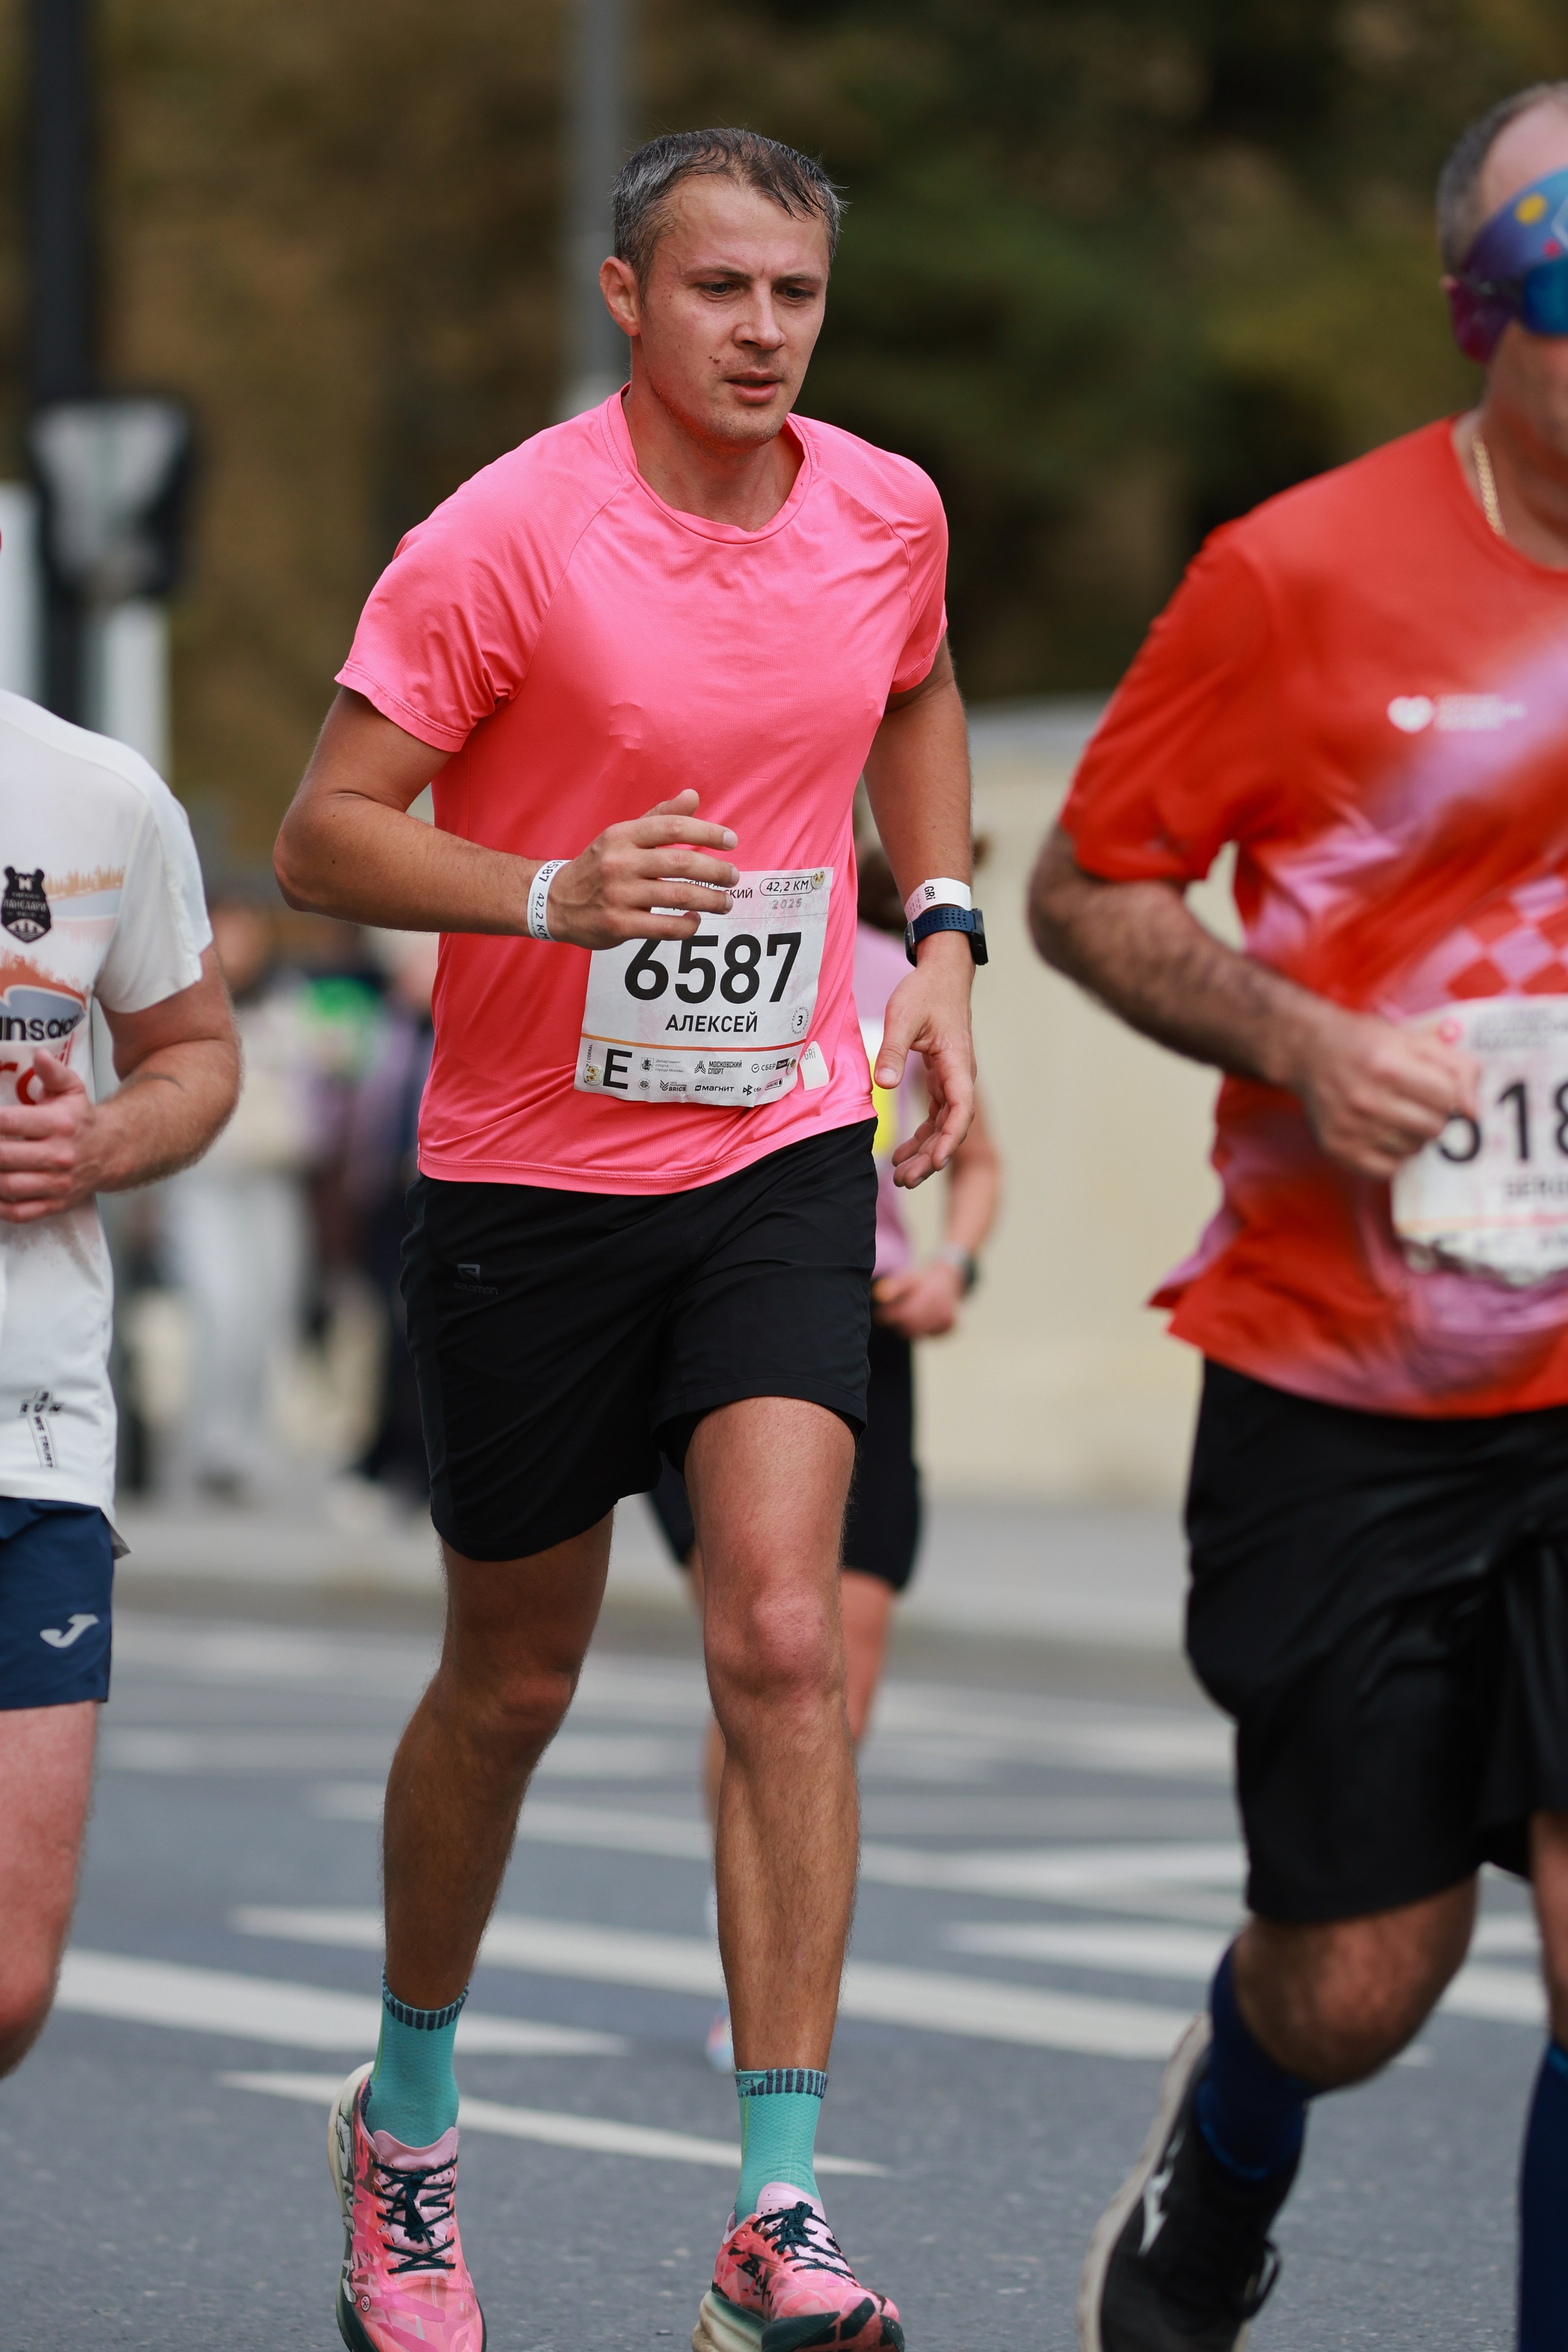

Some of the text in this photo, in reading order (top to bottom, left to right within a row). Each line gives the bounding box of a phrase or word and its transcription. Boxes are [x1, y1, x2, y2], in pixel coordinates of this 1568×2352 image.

[766, 881, 790, 894] 42,2
[924, 886, 936, 900] GRi
[535, 892, 545, 919] 42,2
[771, 897, 802, 910] 2026
[624, 932, 802, 1004] 6587
[665, 1012, 758, 1033] АЛЕКСЕЙ
[797, 1015, 803, 1026] 3
[804, 1048, 816, 1060] GRi
